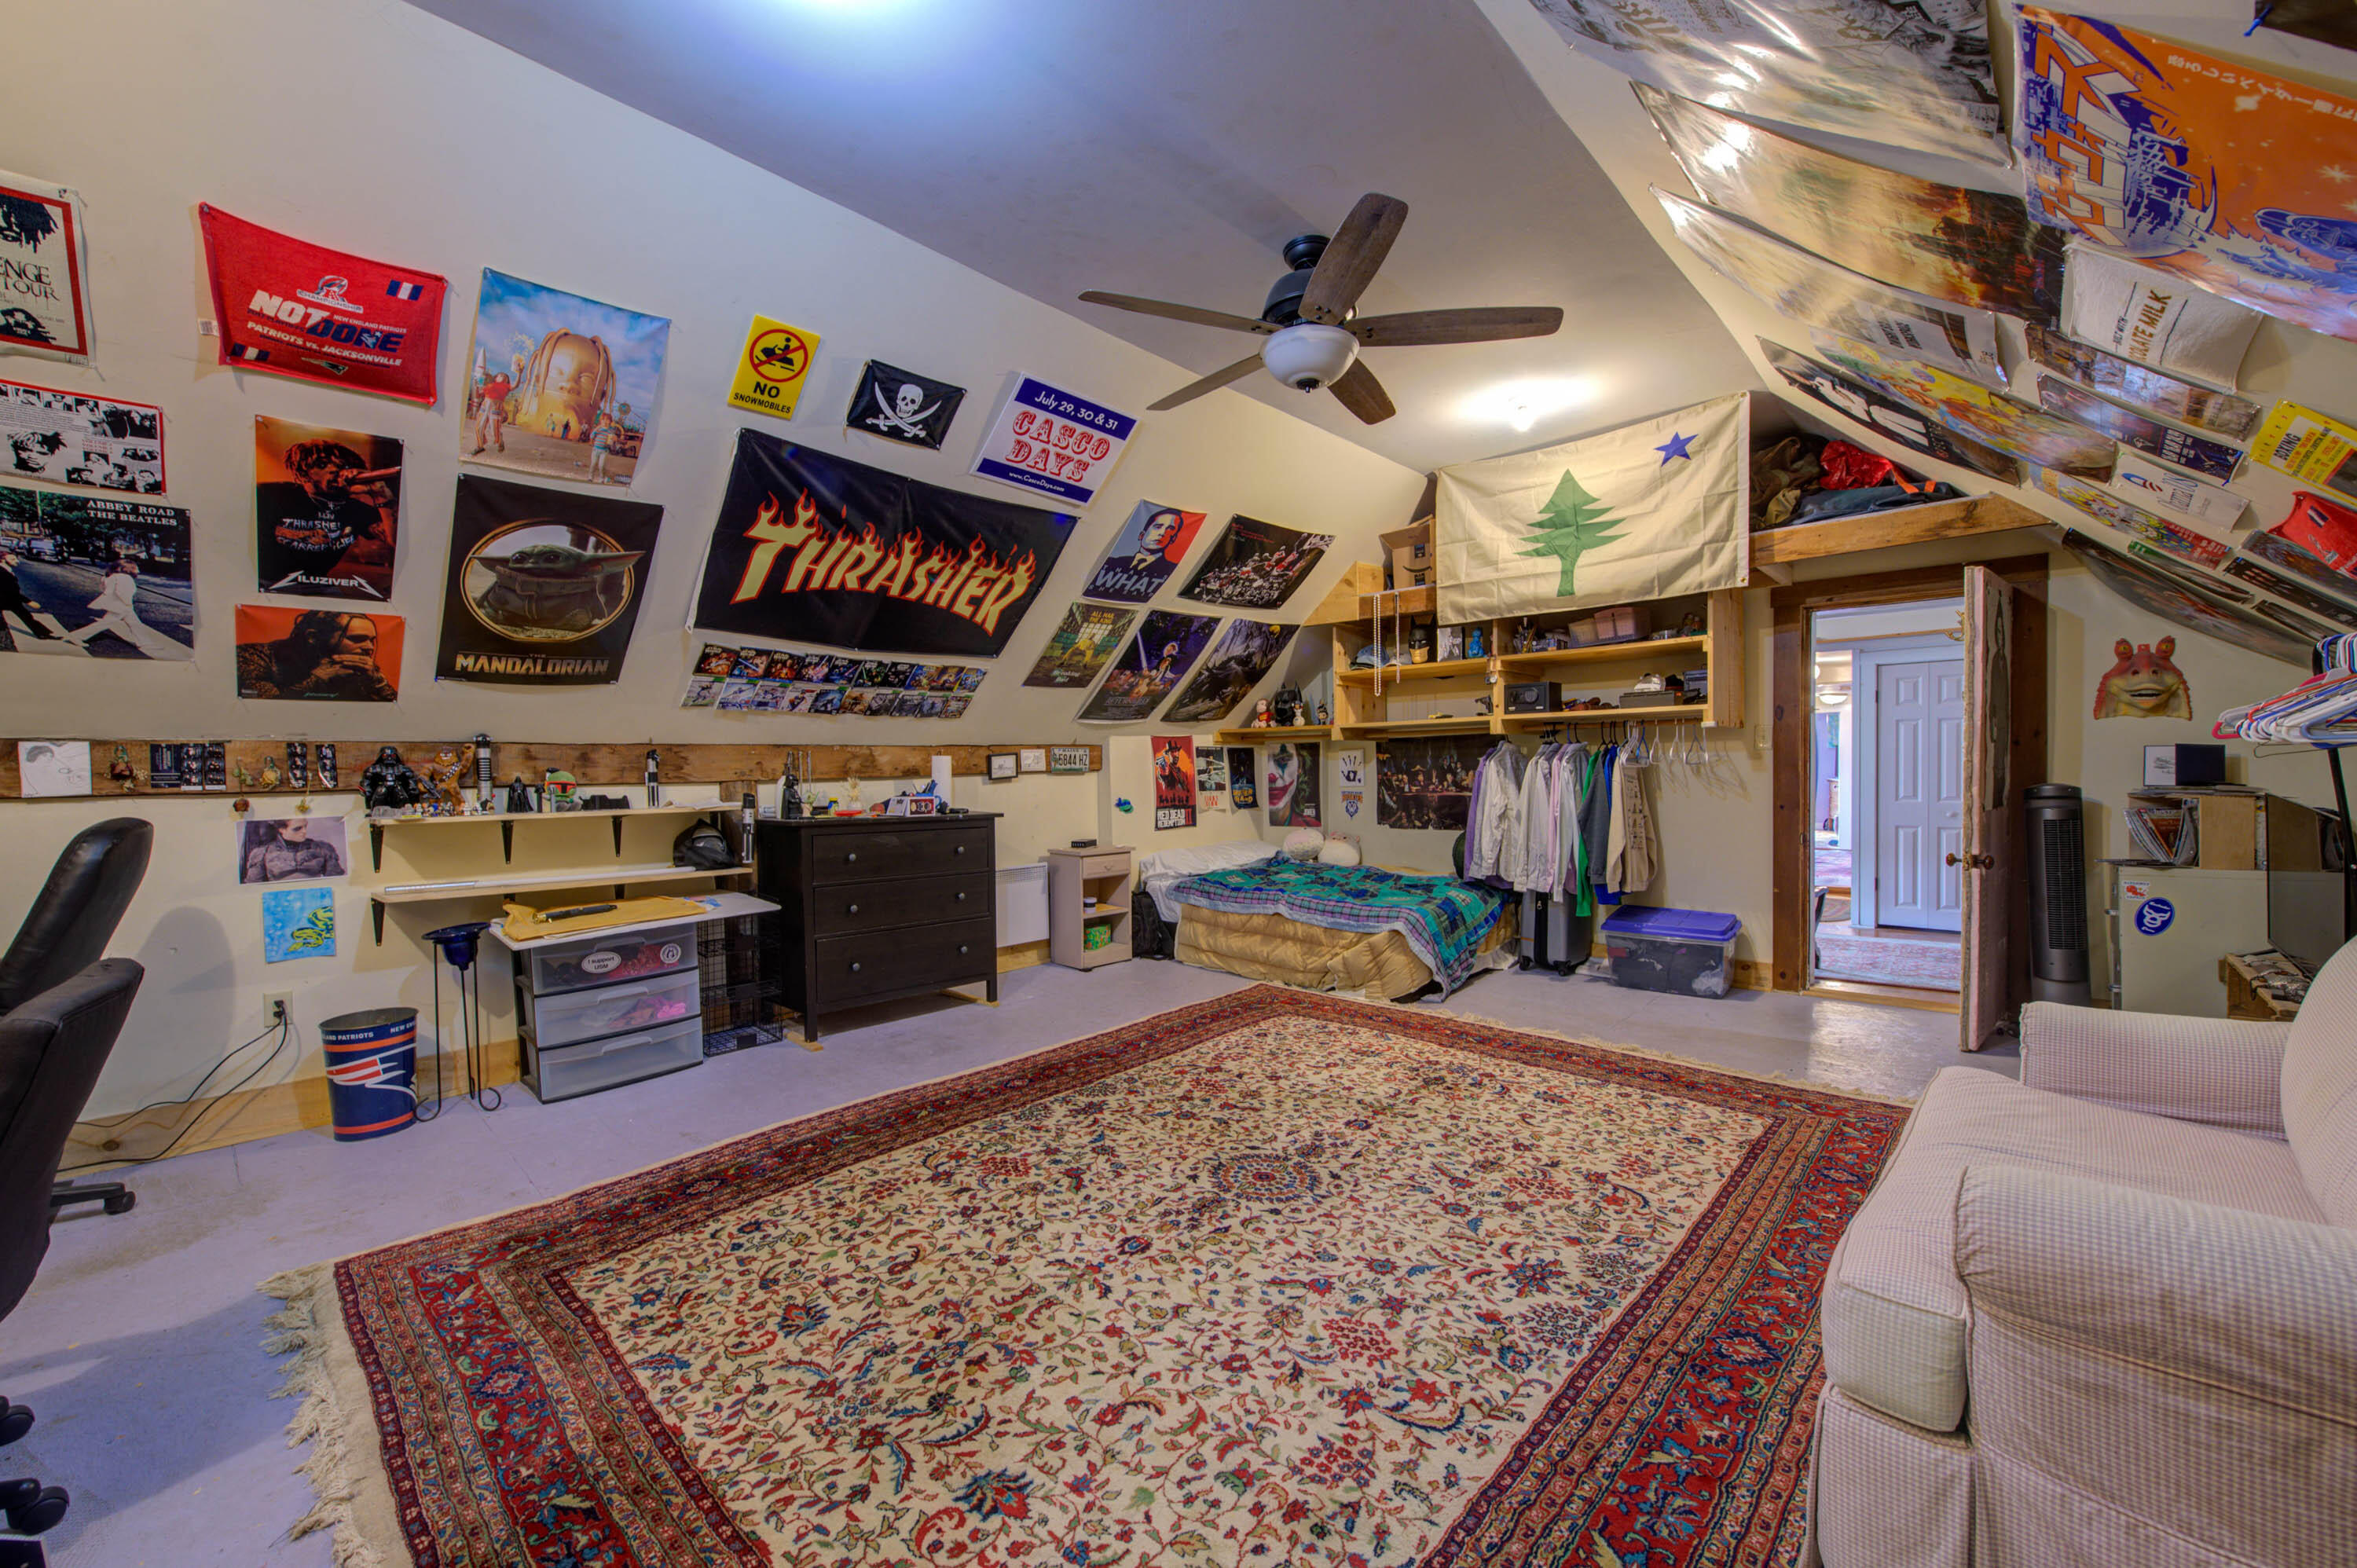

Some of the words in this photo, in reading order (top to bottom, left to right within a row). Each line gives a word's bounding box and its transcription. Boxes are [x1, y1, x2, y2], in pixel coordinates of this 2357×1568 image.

[249, 289, 330, 328] NOT
[2138, 289, 2172, 329] MILK
[306, 319, 404, 353] DONE
[349, 317, 378, 328] ENGLAND
[379, 323, 407, 333] PATRIOTS
[247, 321, 303, 345] PATRIOTS
[321, 345, 402, 366] JACKSONVILLE
[753, 381, 780, 398] NO
[734, 392, 791, 413] SNOWMOBILES
[1035, 391, 1058, 409] July
[1058, 401, 1075, 416] 29,
[1077, 408, 1094, 421] 30
[1095, 414, 1105, 426] &
[1105, 418, 1119, 430] 31
[1013, 410, 1110, 461] CASCO
[2274, 433, 2302, 461] BOXING
[1006, 439, 1091, 483] DAYS
[1009, 471, 1065, 493] www.CascoDays.com
[87, 500, 133, 512] ABBEY
[138, 505, 175, 517] ROAD
[88, 510, 116, 520] THE
[119, 514, 178, 526] BEATLES
[729, 487, 1036, 637] THRASHER
[1095, 570, 1164, 593] WHAT
[455, 654, 610, 676] MANDALORIAN
[1058, 753, 1076, 766] 5844
[1079, 753, 1087, 766] HZ
[1157, 810, 1170, 820] RED
[1170, 808, 1185, 819] DEAD
[592, 956, 614, 965] support
[338, 1031, 374, 1041] PATRIOTS
[390, 1024, 405, 1034] NEW
